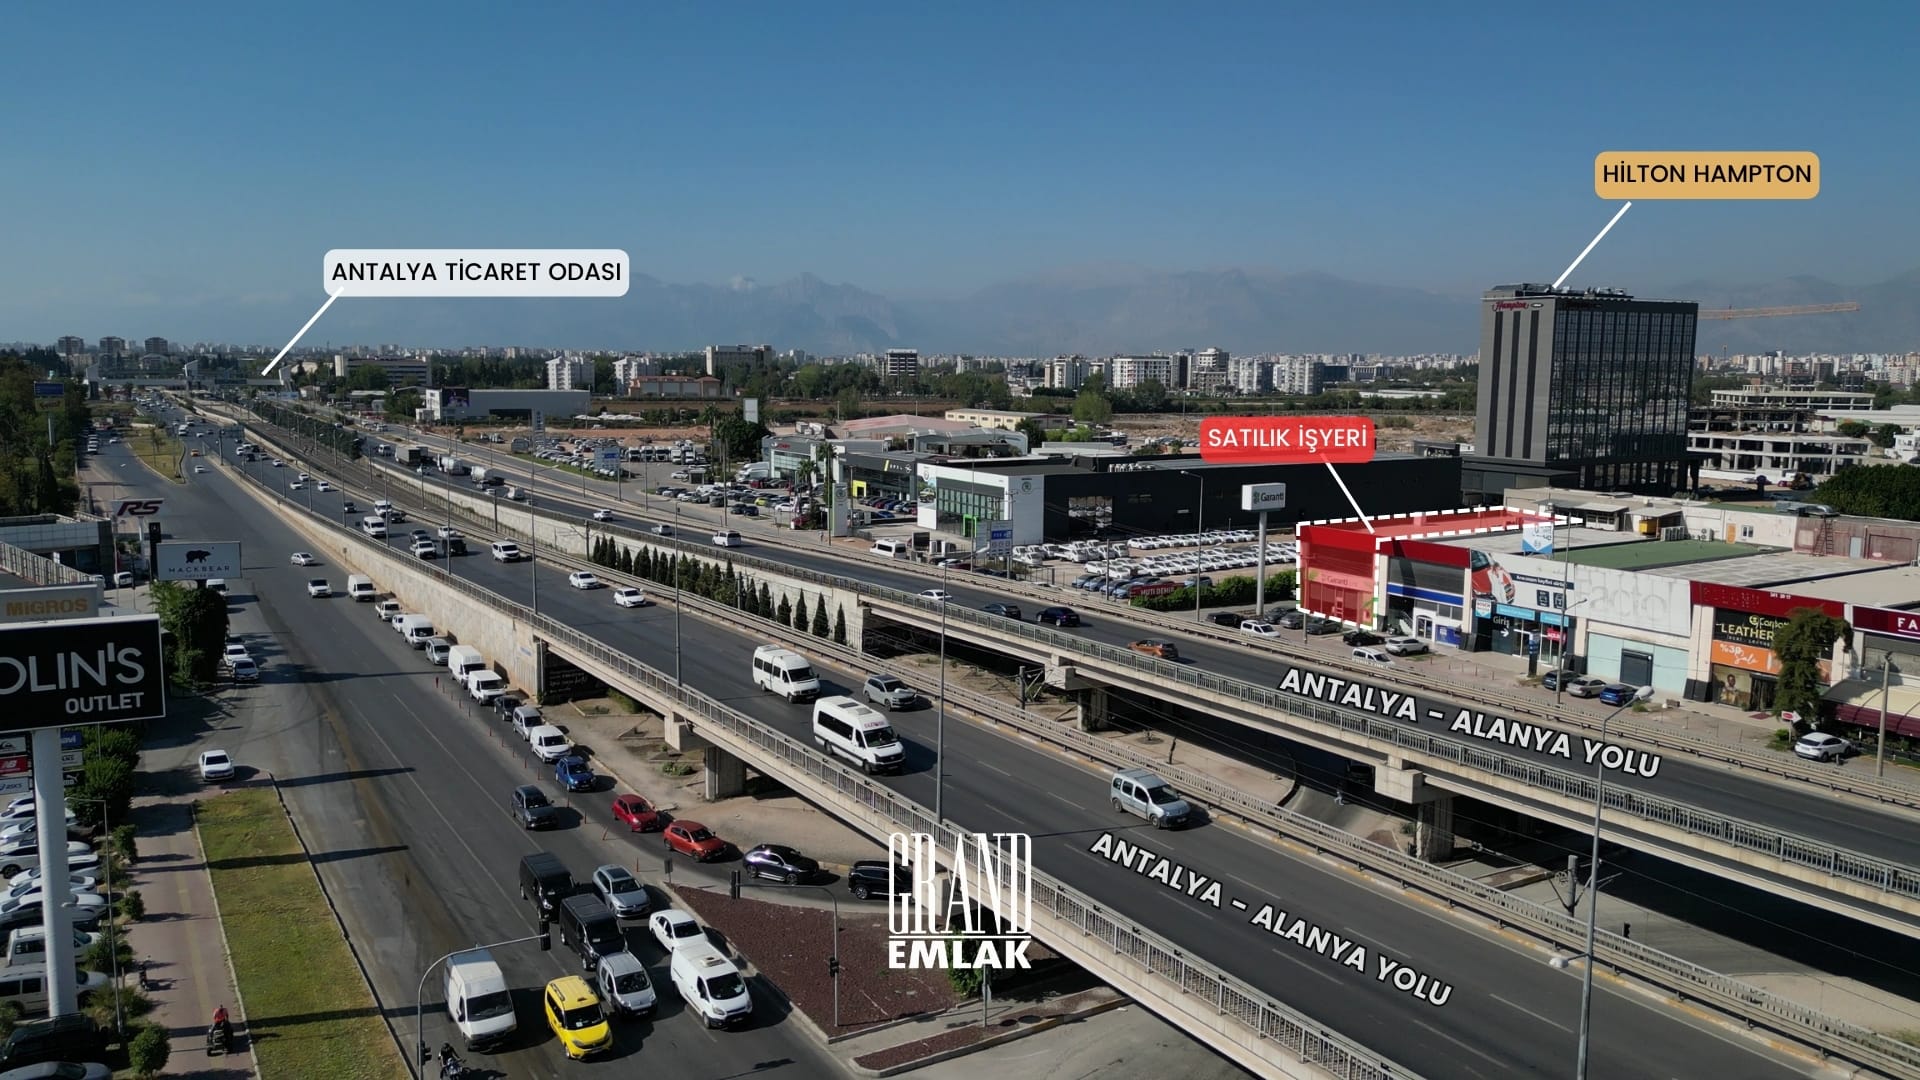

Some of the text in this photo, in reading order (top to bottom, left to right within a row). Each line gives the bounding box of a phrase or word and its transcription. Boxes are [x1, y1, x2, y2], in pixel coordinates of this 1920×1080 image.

[1494, 301, 1528, 311] Hampton
[117, 500, 163, 516] RS
[168, 565, 230, 573] MACKBEAR
[1721, 623, 1775, 640] LEATHER
[65, 692, 145, 714] OUTLET
